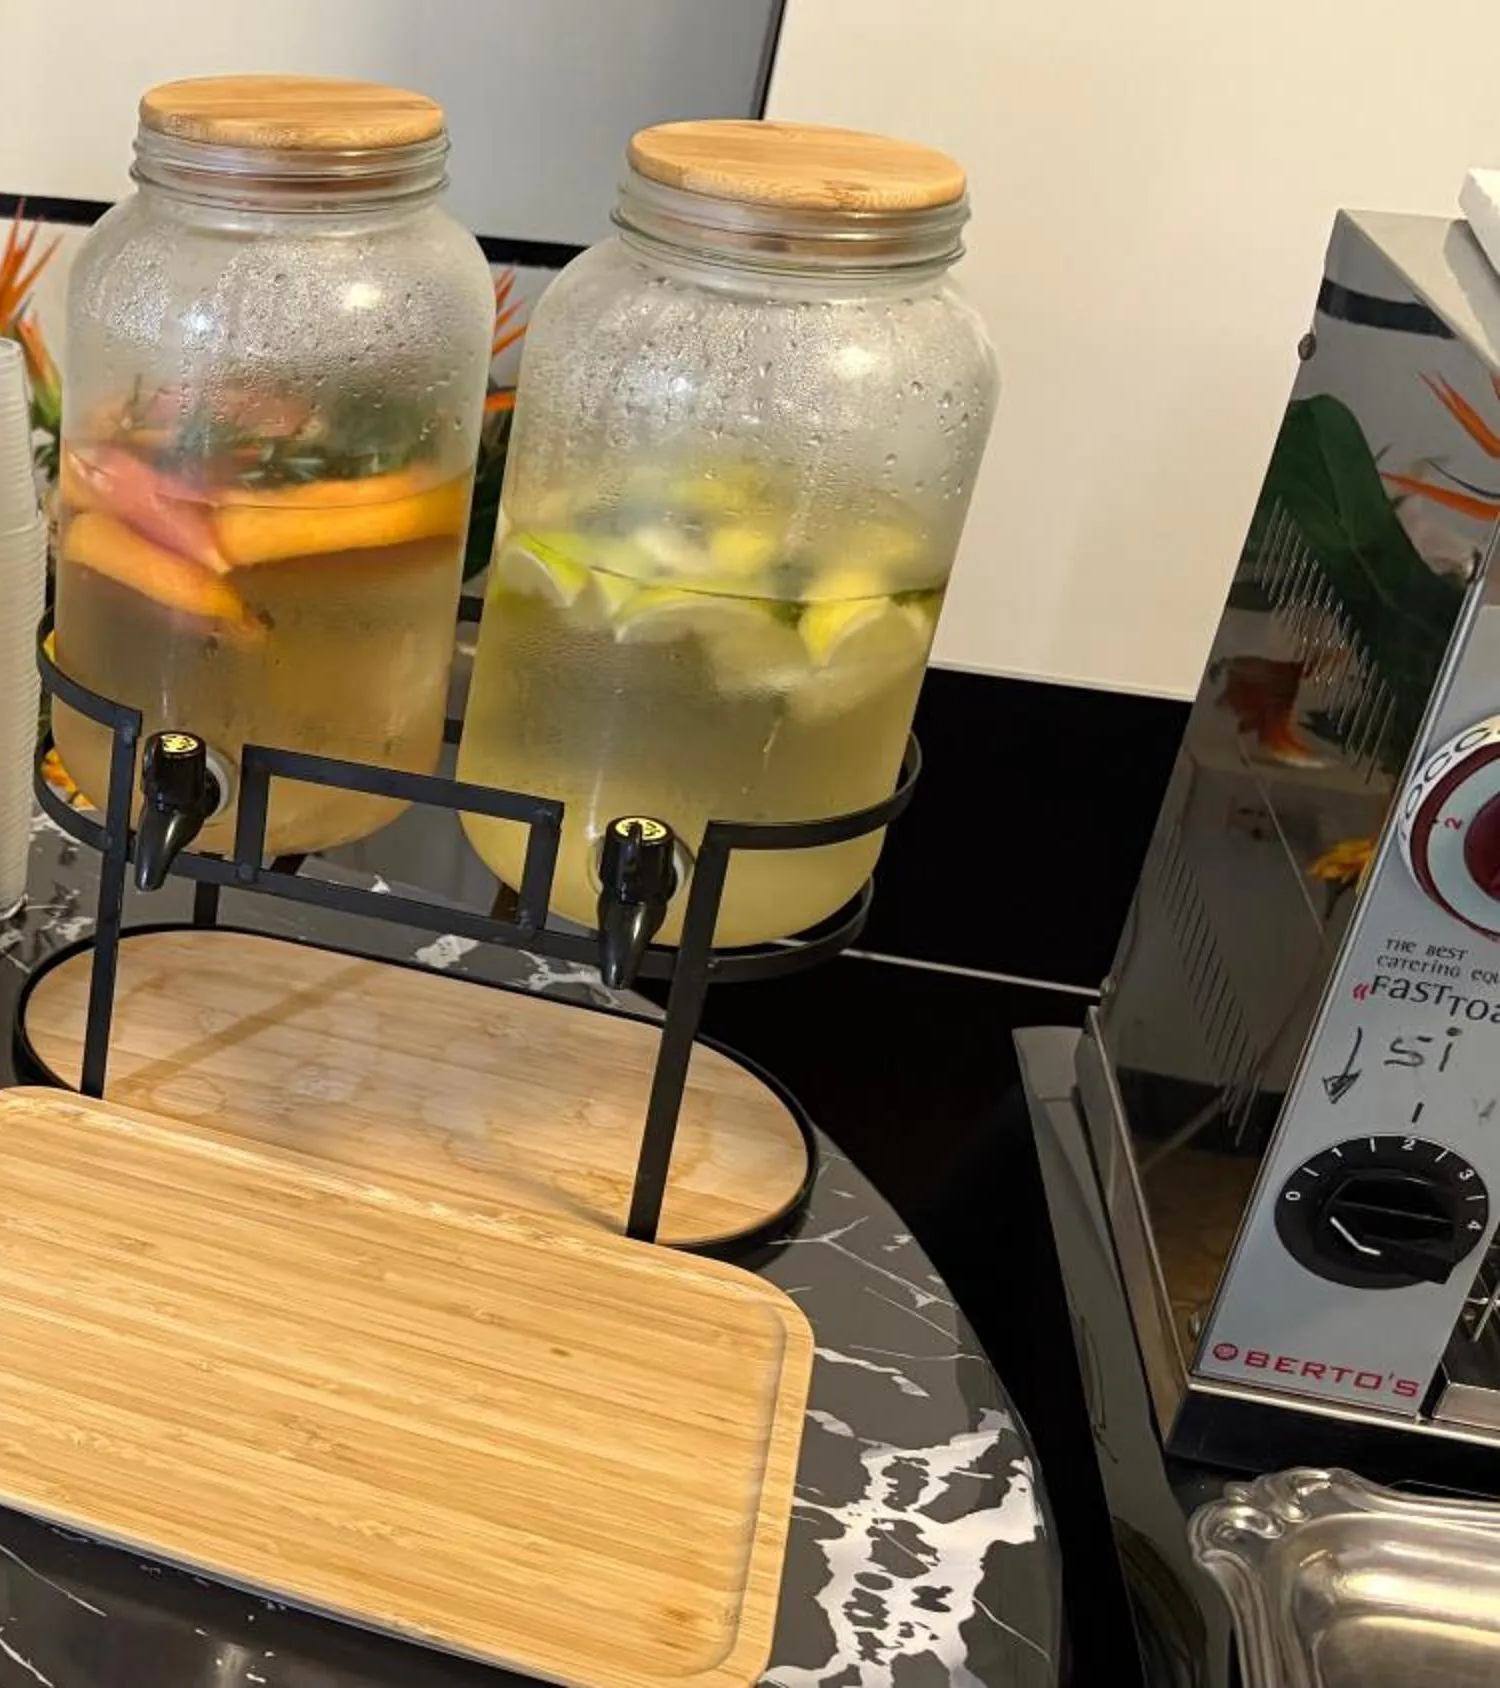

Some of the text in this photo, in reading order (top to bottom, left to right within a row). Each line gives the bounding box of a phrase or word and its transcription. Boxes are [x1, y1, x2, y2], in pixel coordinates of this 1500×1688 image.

[1444, 816, 1463, 831] 2
[1402, 1138, 1416, 1151] 2
[1459, 1168, 1475, 1181] 3
[1243, 1350, 1420, 1397] BERTO'S
